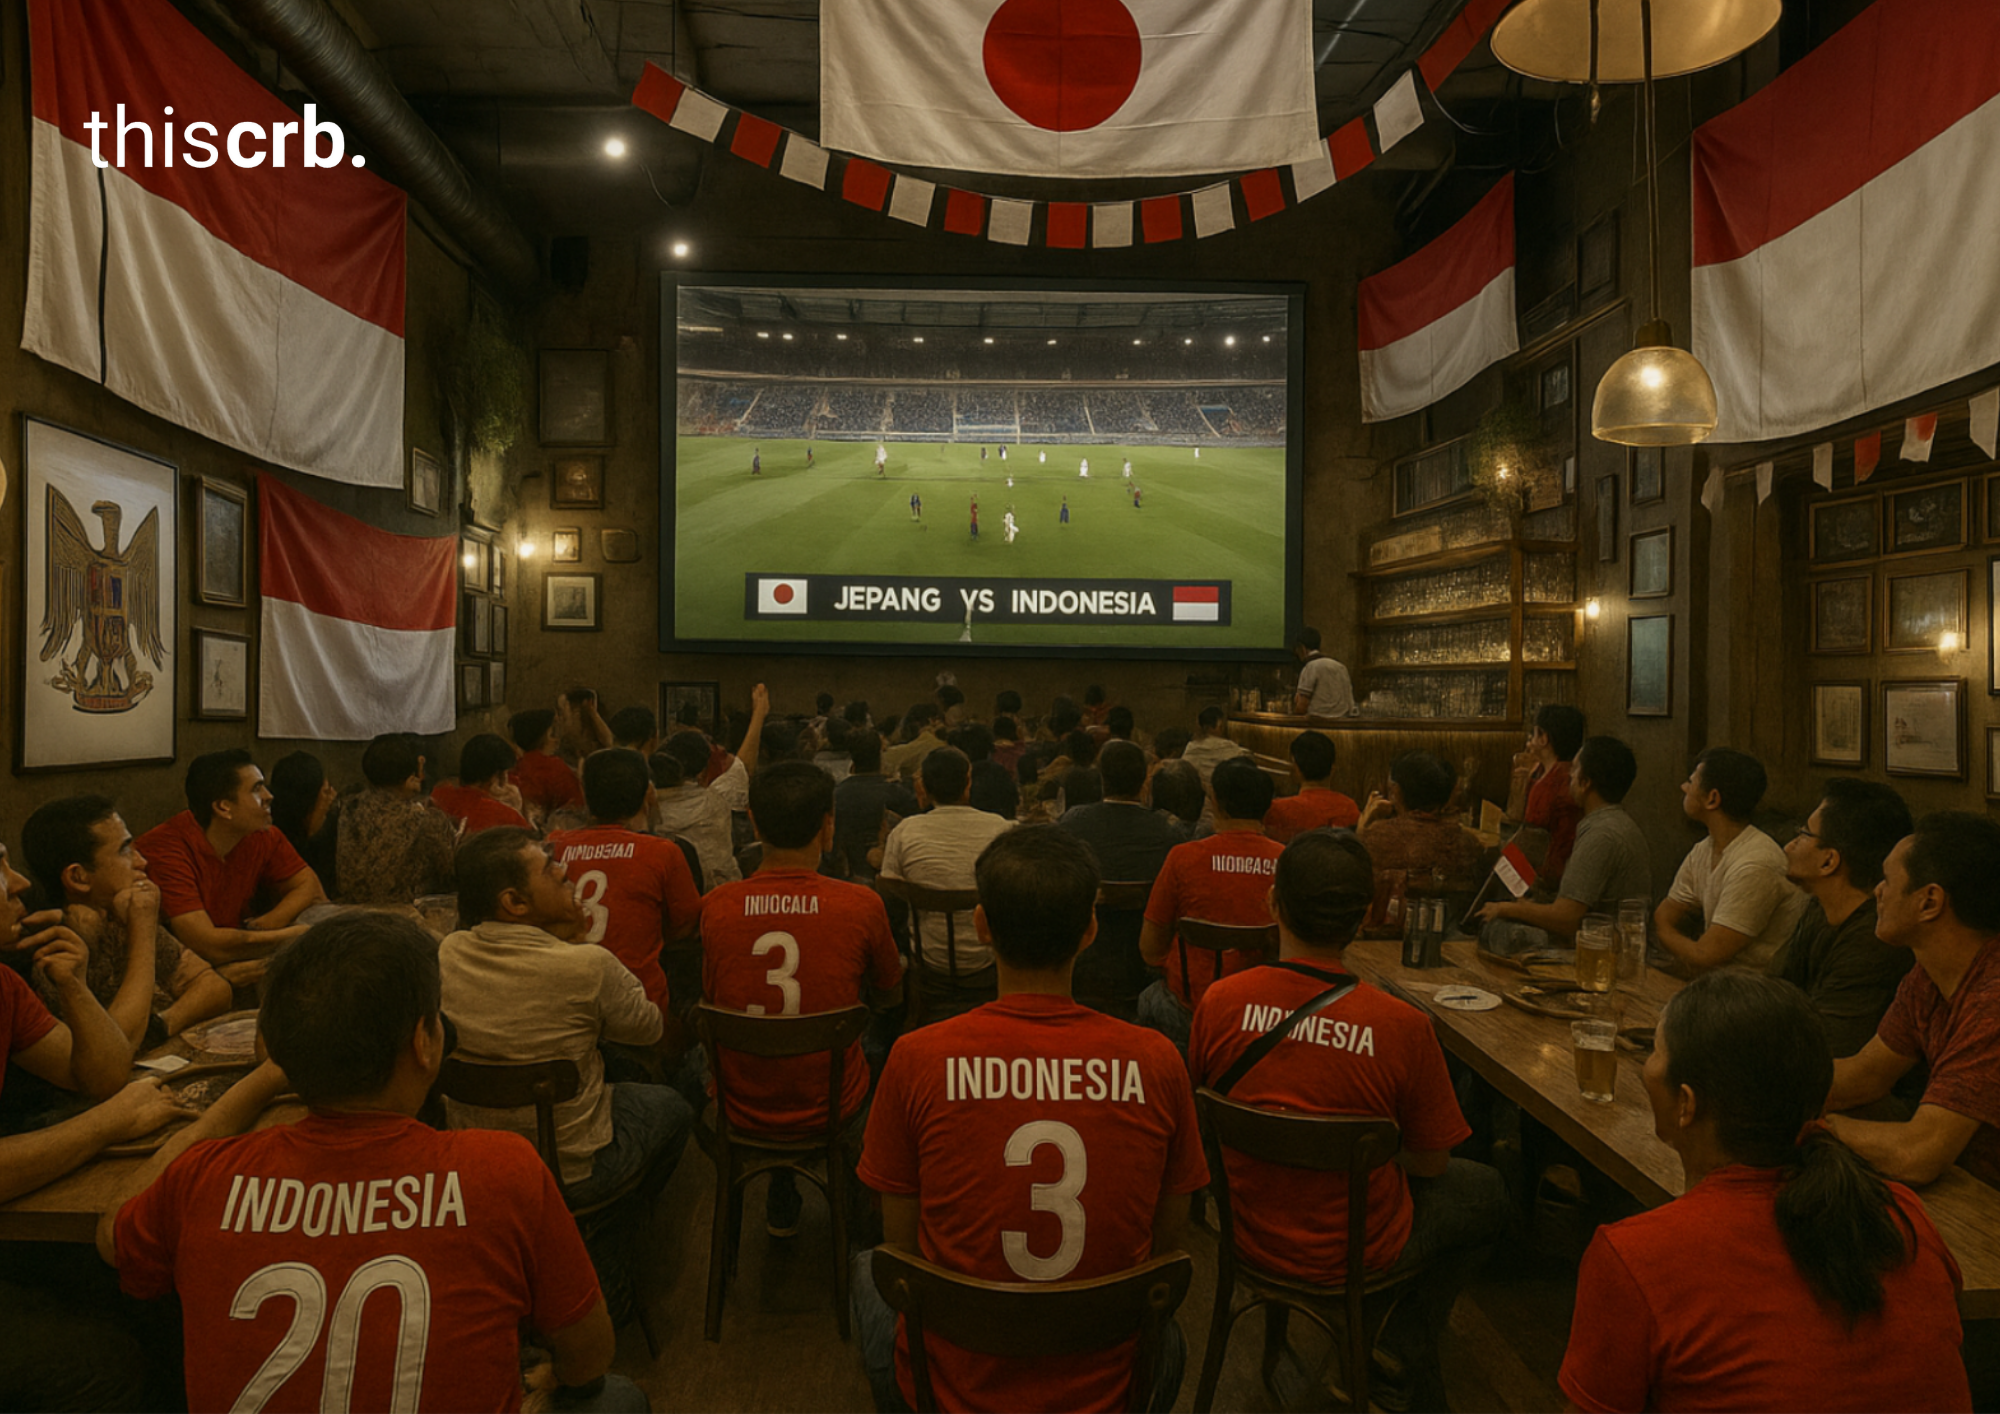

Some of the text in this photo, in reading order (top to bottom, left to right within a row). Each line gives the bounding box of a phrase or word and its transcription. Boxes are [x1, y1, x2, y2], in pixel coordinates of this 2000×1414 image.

[833, 585, 1156, 616] JEPANG VS INDONESIA
[746, 931, 801, 1015] 3
[946, 1056, 1146, 1104] INDONESIA
[219, 1171, 468, 1238] INDONESIA
[1001, 1120, 1088, 1281] 3
[228, 1254, 431, 1414] 20
